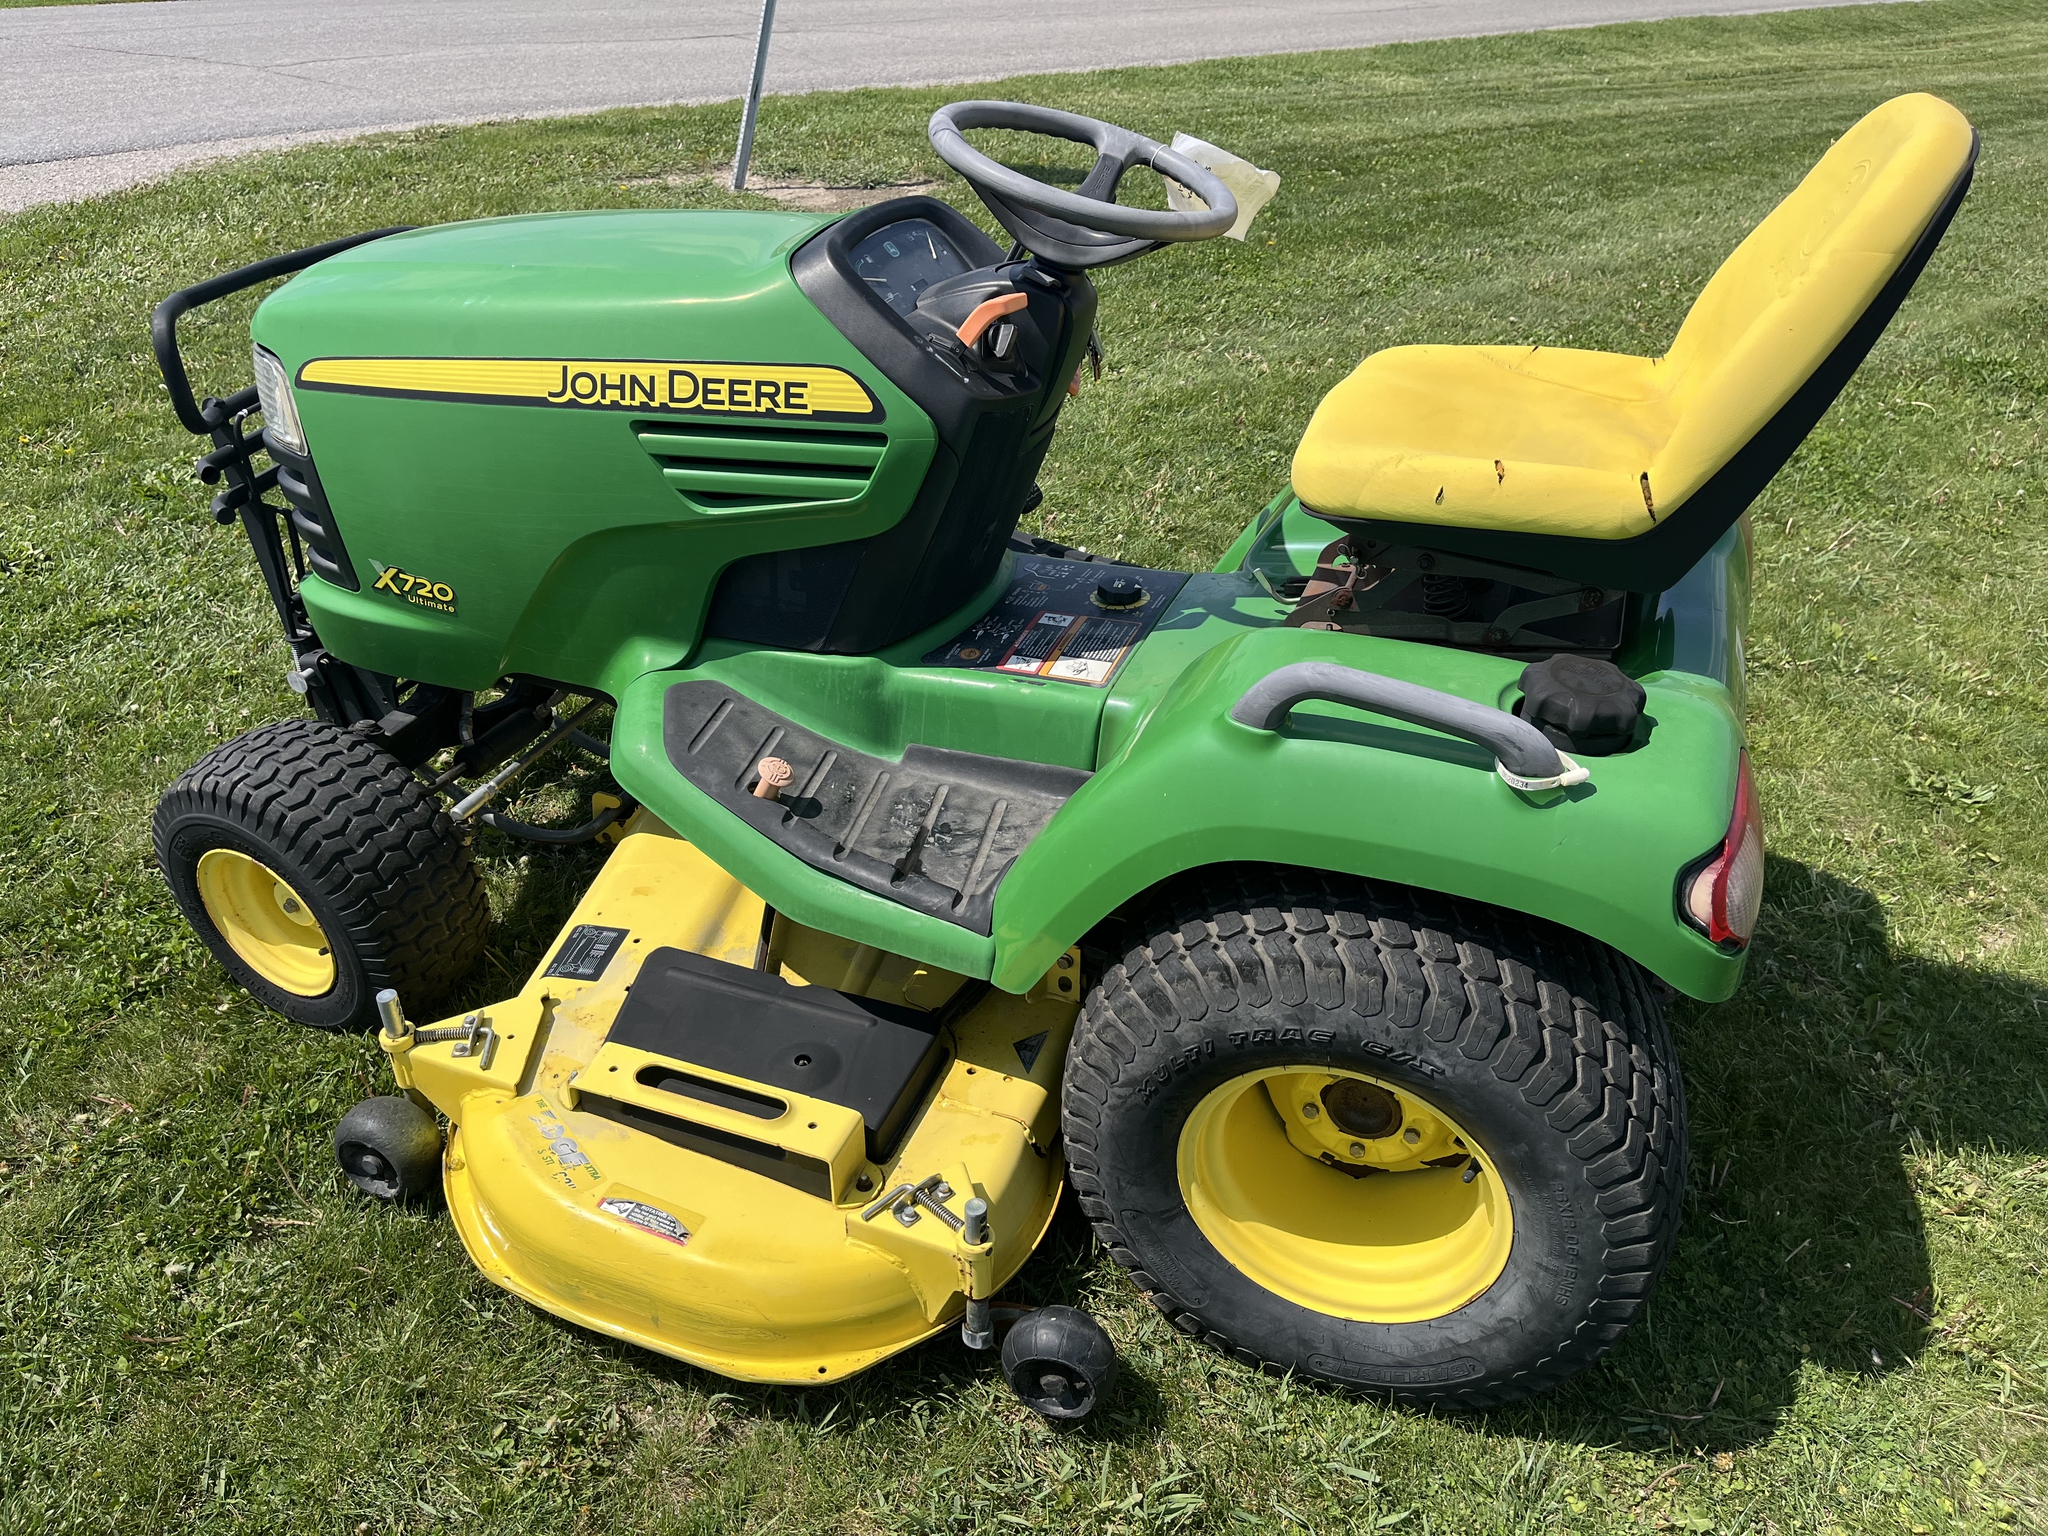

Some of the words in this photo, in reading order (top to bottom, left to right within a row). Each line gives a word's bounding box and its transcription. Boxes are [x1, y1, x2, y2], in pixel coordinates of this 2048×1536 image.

[549, 364, 658, 405] JOHN
[667, 368, 811, 414] DEERE
[370, 561, 454, 602] X720
[407, 594, 455, 613] Ultimate
[1135, 1039, 1217, 1104] MULTI
[1228, 1026, 1337, 1049] TRAC
[584, 1165, 602, 1181] XTRA
[1321, 1358, 1472, 1384] CARLISLE
